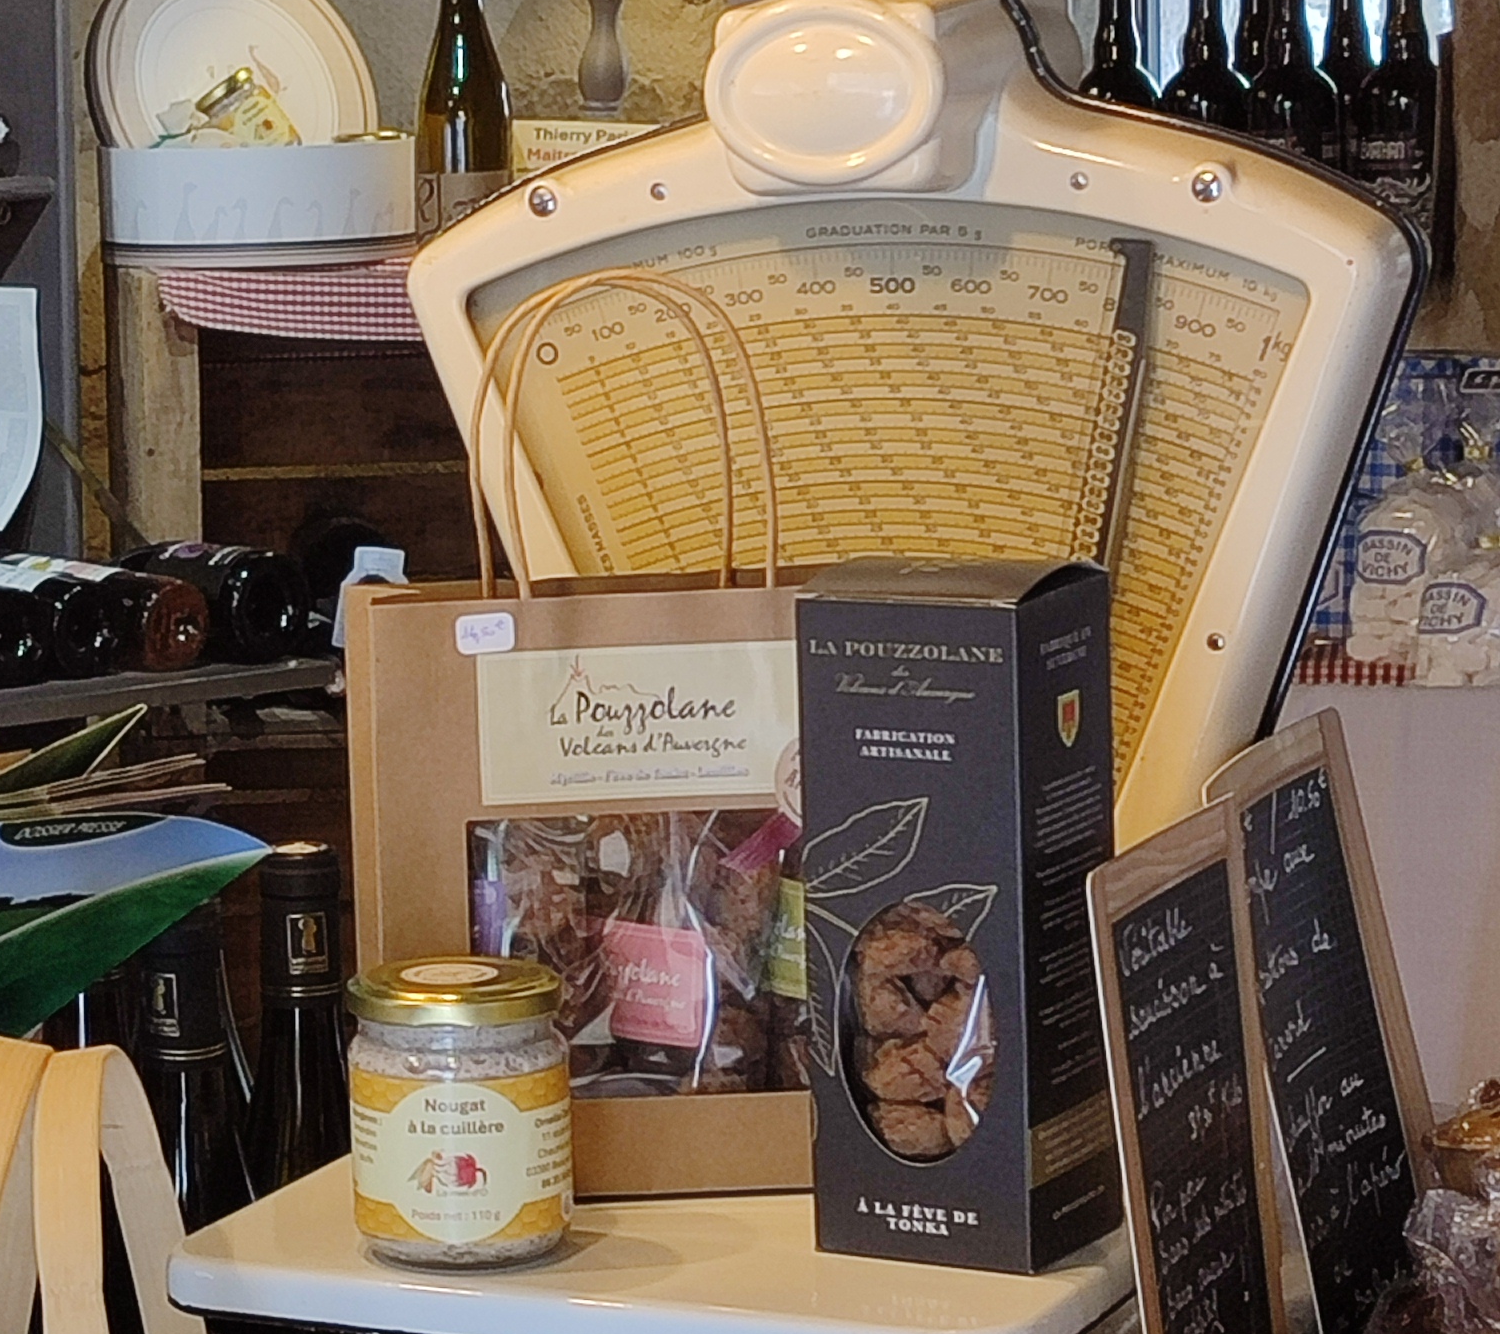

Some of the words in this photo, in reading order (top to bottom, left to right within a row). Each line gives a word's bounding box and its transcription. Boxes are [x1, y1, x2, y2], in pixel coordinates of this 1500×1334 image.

[534, 128, 592, 144] Thierry
[806, 224, 912, 239] GRADUATION
[919, 225, 950, 236] PAR
[678, 246, 705, 261] 100
[591, 322, 625, 341] 100
[628, 302, 647, 315] 50
[654, 302, 692, 323] 200
[724, 289, 763, 307] 300
[768, 273, 787, 285] 50
[796, 280, 836, 296] 400
[844, 267, 864, 278] 50
[869, 277, 915, 294] 500
[922, 265, 942, 277] 50
[951, 278, 992, 295] 600
[1000, 270, 1020, 283] 50
[1027, 285, 1069, 304] 700
[1078, 280, 1099, 294] 50
[1174, 315, 1217, 338] 900
[1226, 317, 1246, 332] 50
[1362, 538, 1413, 556] BASSIN
[1374, 552, 1391, 564] DE
[1362, 561, 1409, 578] VICHY
[1428, 592, 1471, 608] ASSIN
[1430, 604, 1447, 615] DE
[1420, 612, 1465, 628] ICHY
[809, 639, 838, 655] LA
[845, 641, 1004, 664] POUZZOLANE
[575, 686, 736, 735] Pouzzolane
[855, 728, 956, 745] FABRICATION
[560, 736, 637, 757] Volcans
[643, 732, 748, 758] d'Auvergne
[859, 746, 953, 762] ARTISANALE
[424, 1099, 486, 1115] Nougat
[408, 1120, 418, 1134] à
[421, 1121, 436, 1134] la
[440, 1120, 505, 1135] cuillère
[857, 1196, 869, 1213] À
[874, 1202, 896, 1216] LA
[902, 1203, 947, 1222] FÈVE
[953, 1211, 979, 1226] DE
[886, 1217, 949, 1237] TONKA
